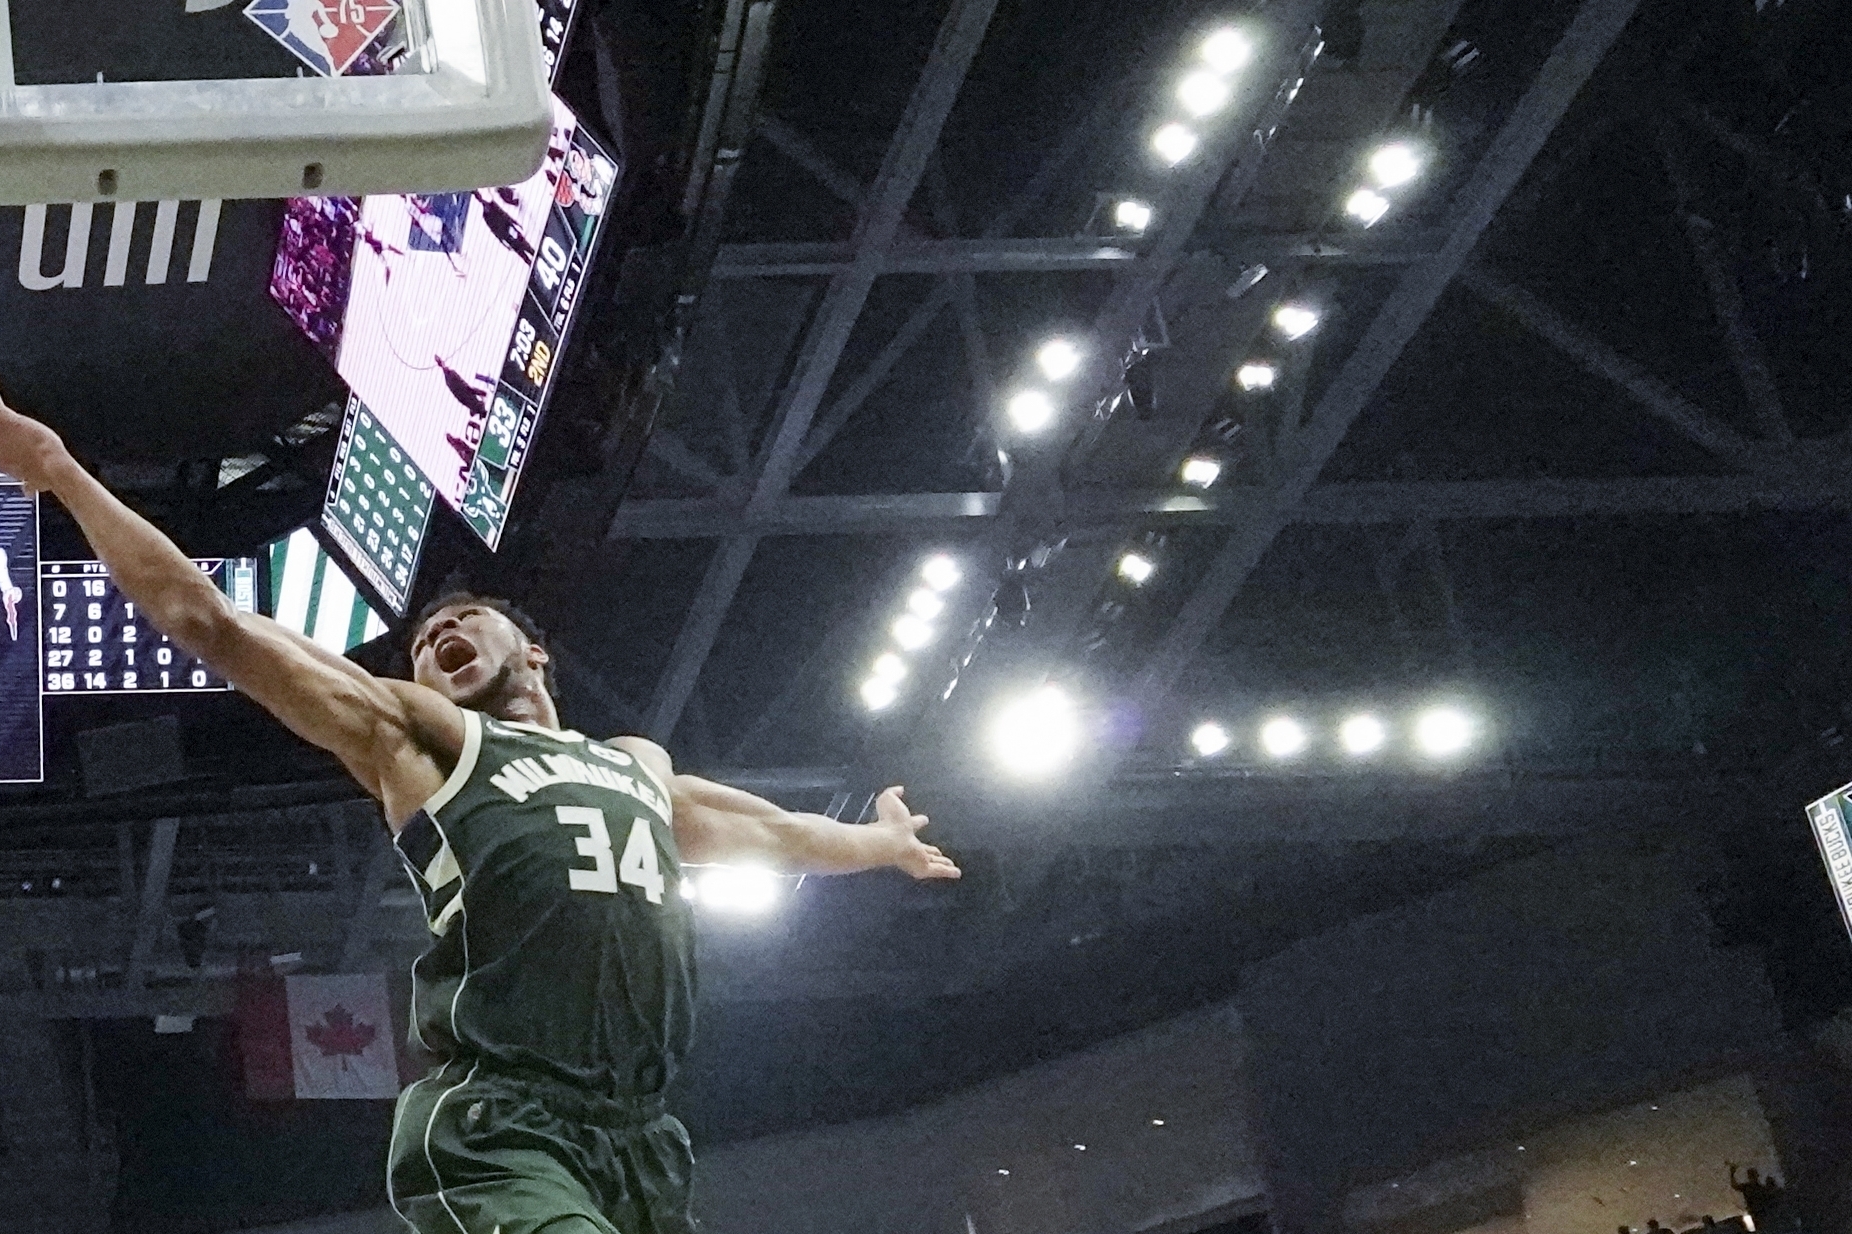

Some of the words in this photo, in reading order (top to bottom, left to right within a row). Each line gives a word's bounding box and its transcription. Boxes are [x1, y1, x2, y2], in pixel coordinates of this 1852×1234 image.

[537, 237, 567, 290] 40
[511, 318, 536, 371] 7:03
[529, 340, 551, 386] 2ND
[489, 397, 517, 448] 33
[53, 581, 66, 597] 0
[83, 580, 105, 596] 16
[54, 604, 66, 620] 7
[88, 603, 101, 619] 6
[125, 603, 133, 619] 1
[49, 627, 71, 643] 12
[88, 626, 102, 643] 0
[123, 626, 136, 642] 2
[48, 650, 73, 666] 27
[89, 650, 102, 666] 2
[126, 649, 134, 665] 1
[157, 648, 171, 664] 0
[48, 673, 74, 690] 36
[84, 673, 106, 689] 14
[124, 672, 137, 688] 2
[161, 671, 169, 687] 1
[192, 670, 206, 687] 0
[556, 806, 664, 904] 34
